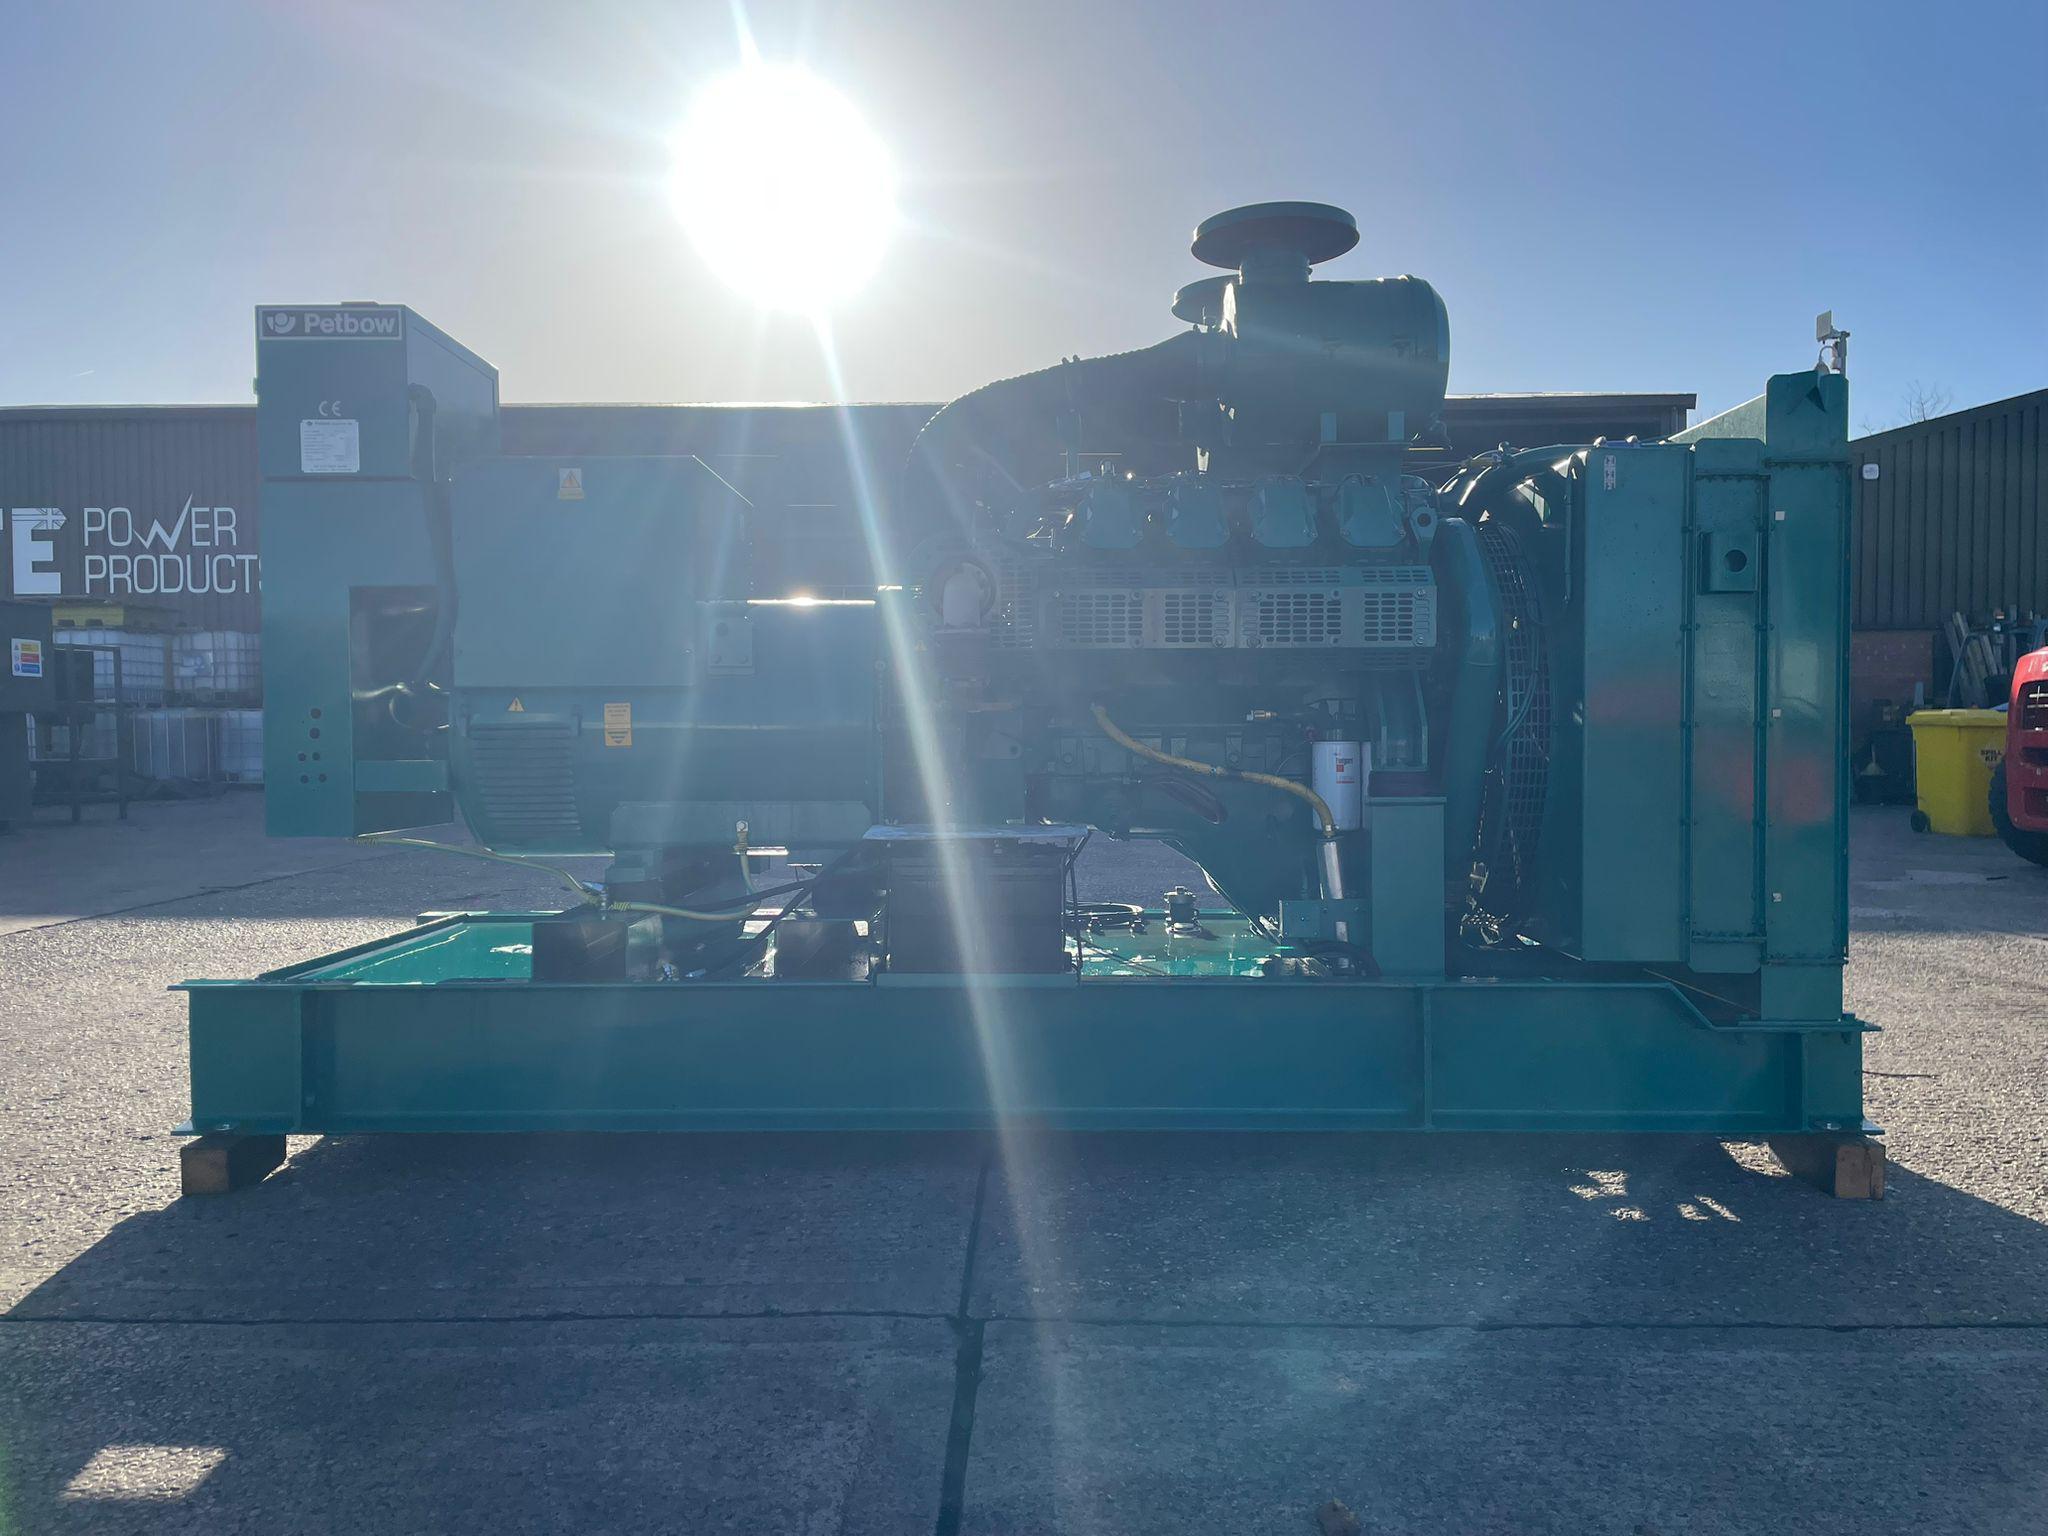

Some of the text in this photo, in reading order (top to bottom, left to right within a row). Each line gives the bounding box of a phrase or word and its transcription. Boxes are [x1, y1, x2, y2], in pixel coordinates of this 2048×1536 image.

[304, 312, 396, 334] Petbow
[319, 400, 341, 416] CE
[83, 492, 237, 552] POWER
[0, 507, 67, 595] E
[84, 554, 262, 594] PRODUCT
